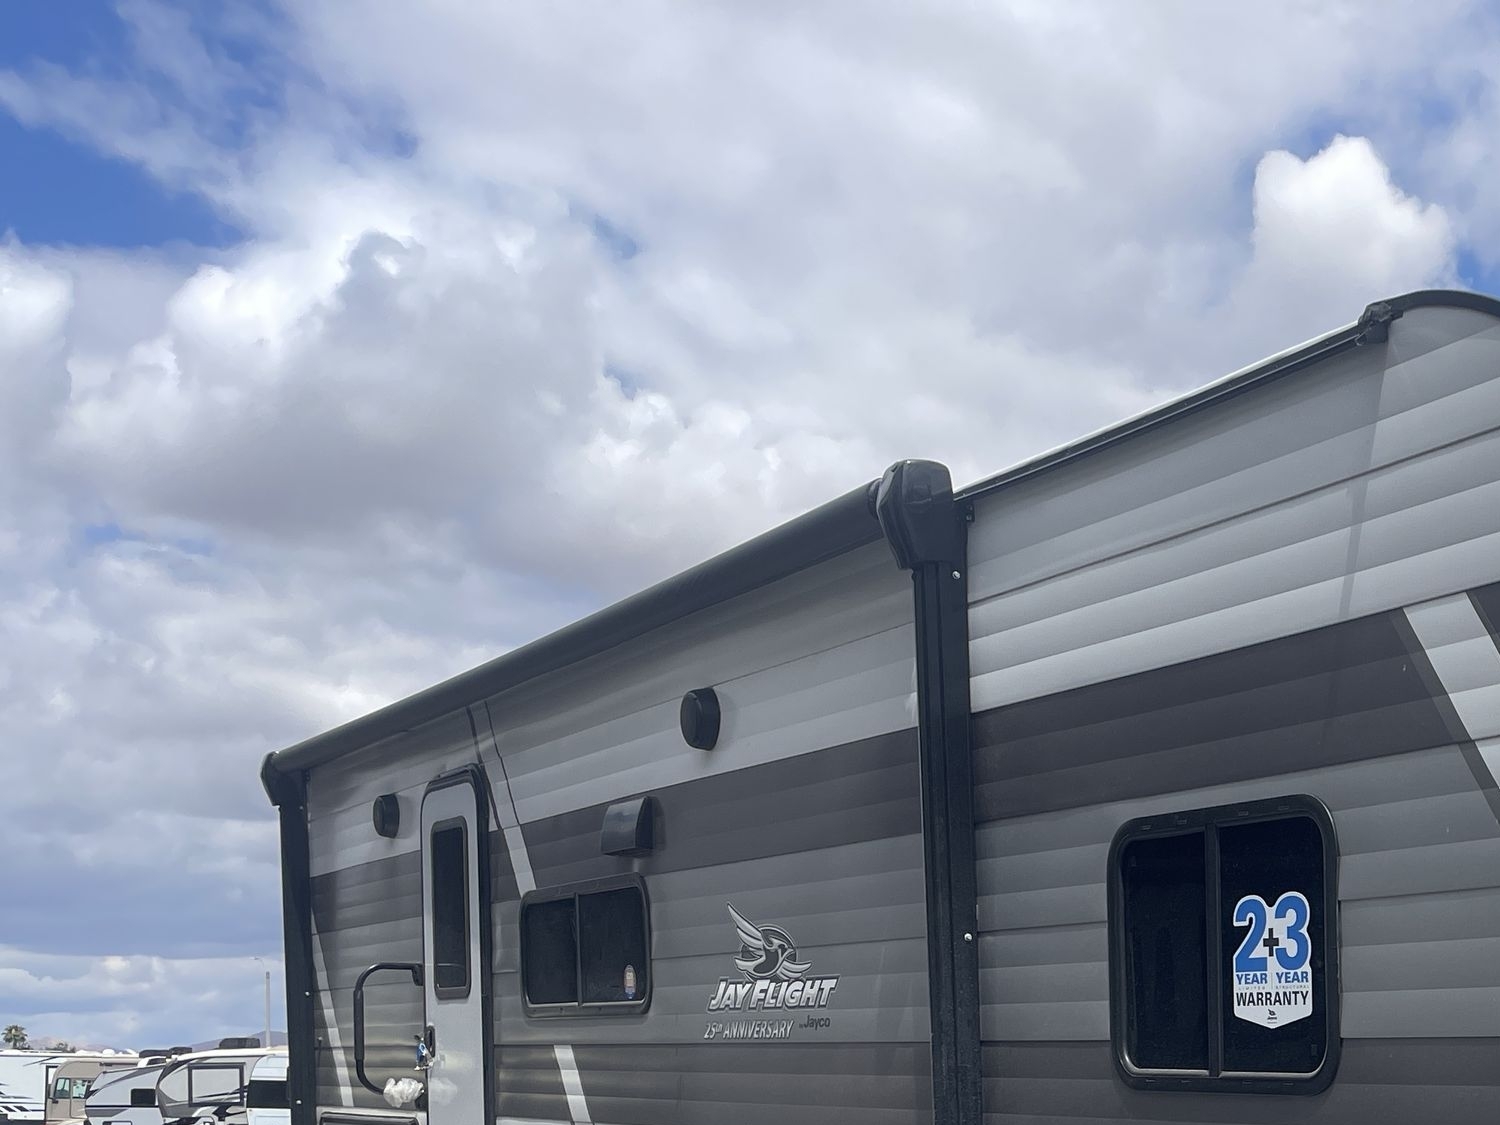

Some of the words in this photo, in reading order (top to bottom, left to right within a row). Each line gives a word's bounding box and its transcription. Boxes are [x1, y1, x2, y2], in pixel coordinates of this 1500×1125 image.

[1236, 973, 1267, 985] YEAR
[1276, 971, 1309, 984] YEAR
[709, 980, 752, 1010] JAY
[749, 977, 838, 1008] FLIGHT
[1236, 991, 1309, 1006] WARRANTY
[723, 1020, 794, 1039] ANNIVERSARY
[804, 1015, 831, 1030] Jayco
